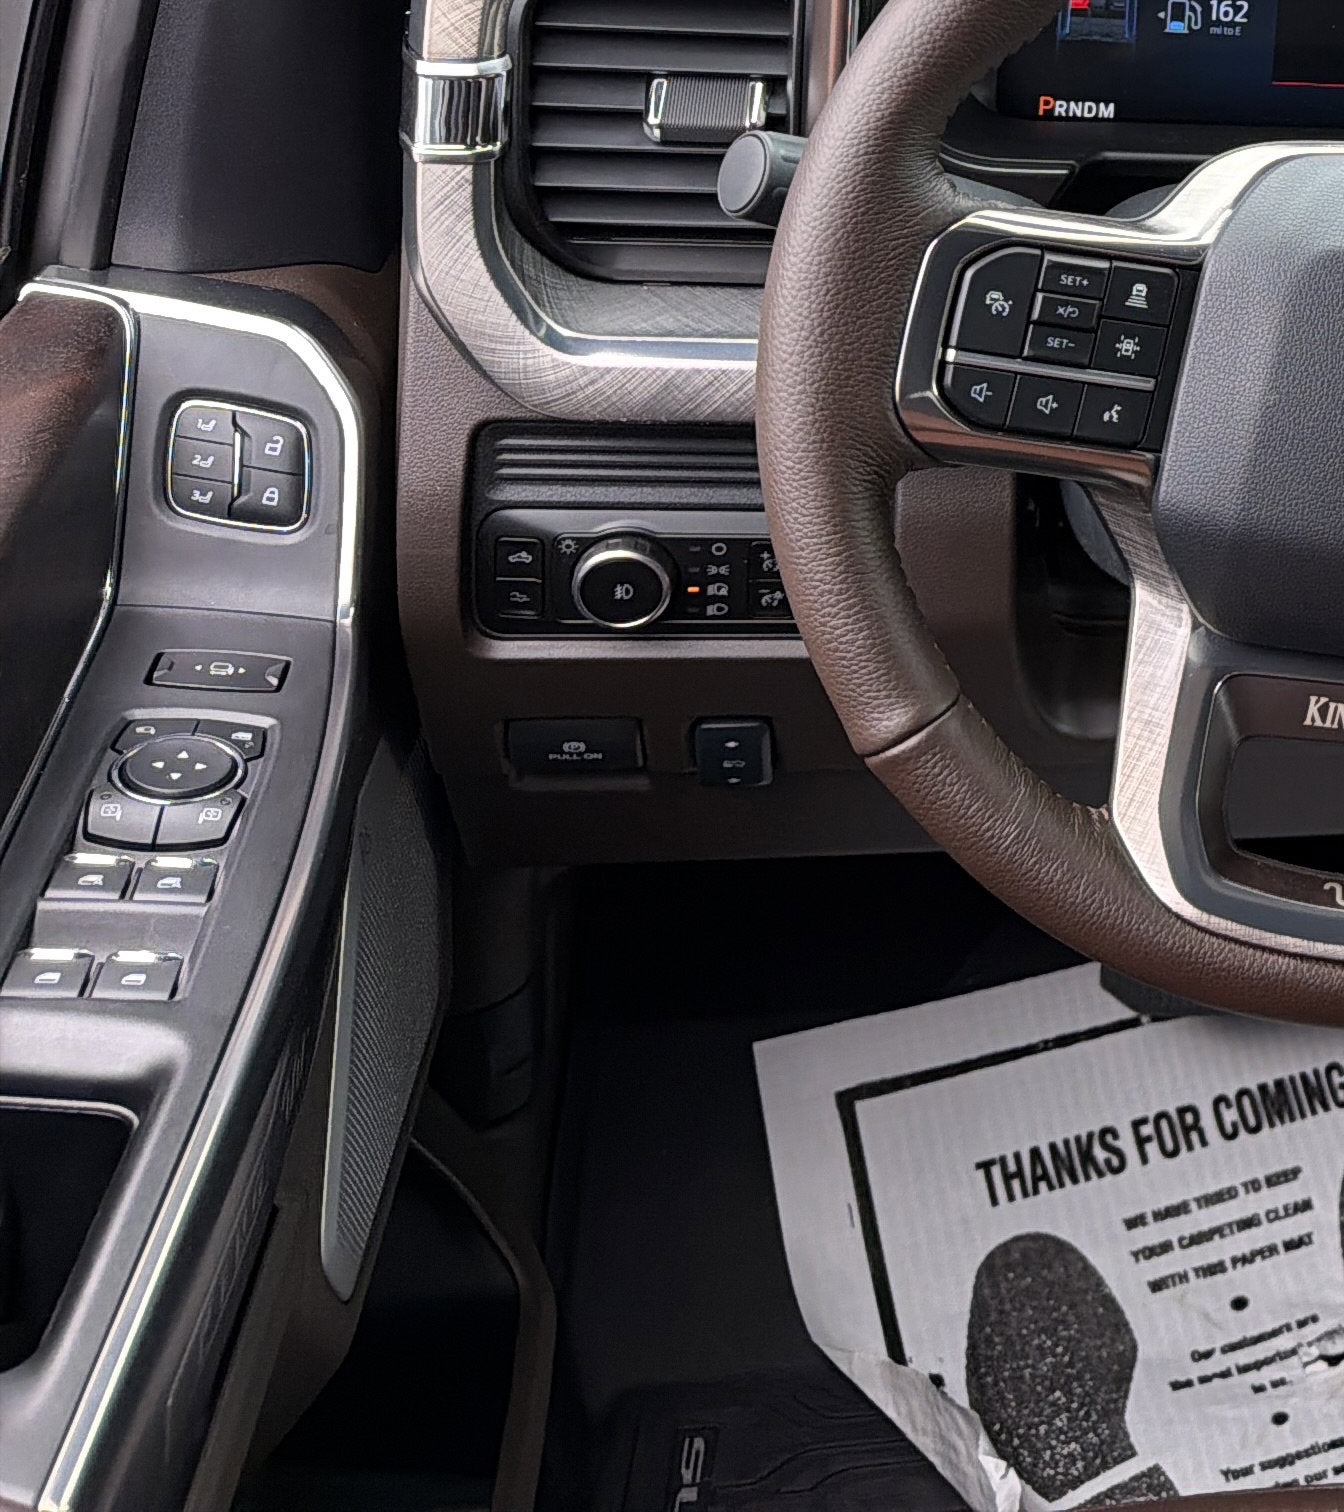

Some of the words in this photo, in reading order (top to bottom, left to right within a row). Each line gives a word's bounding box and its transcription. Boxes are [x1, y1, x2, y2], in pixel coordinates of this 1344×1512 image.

[1210, 0, 1249, 22] 162
[1059, 273, 1089, 287] SET+
[549, 752, 581, 760] PULL
[583, 751, 603, 760] ON
[975, 1126, 1127, 1207] THANKS
[1132, 1104, 1209, 1166] FOR
[1123, 1212, 1148, 1231] WE
[1152, 1199, 1192, 1223] HAVE
[1193, 1185, 1239, 1210] TRIED
[1240, 1178, 1262, 1195] TO
[1264, 1165, 1303, 1188] KEEP
[1130, 1239, 1175, 1263] YOUR
[1177, 1212, 1262, 1249] CARPETING
[1265, 1196, 1314, 1224] CLEAN
[1147, 1269, 1190, 1293] WITH
[1191, 1259, 1228, 1280] THIS
[1230, 1243, 1280, 1270] PAPER
[1282, 1232, 1314, 1253] MAT
[1220, 1464, 1255, 1482] Your
[1304, 1469, 1329, 1485] our
